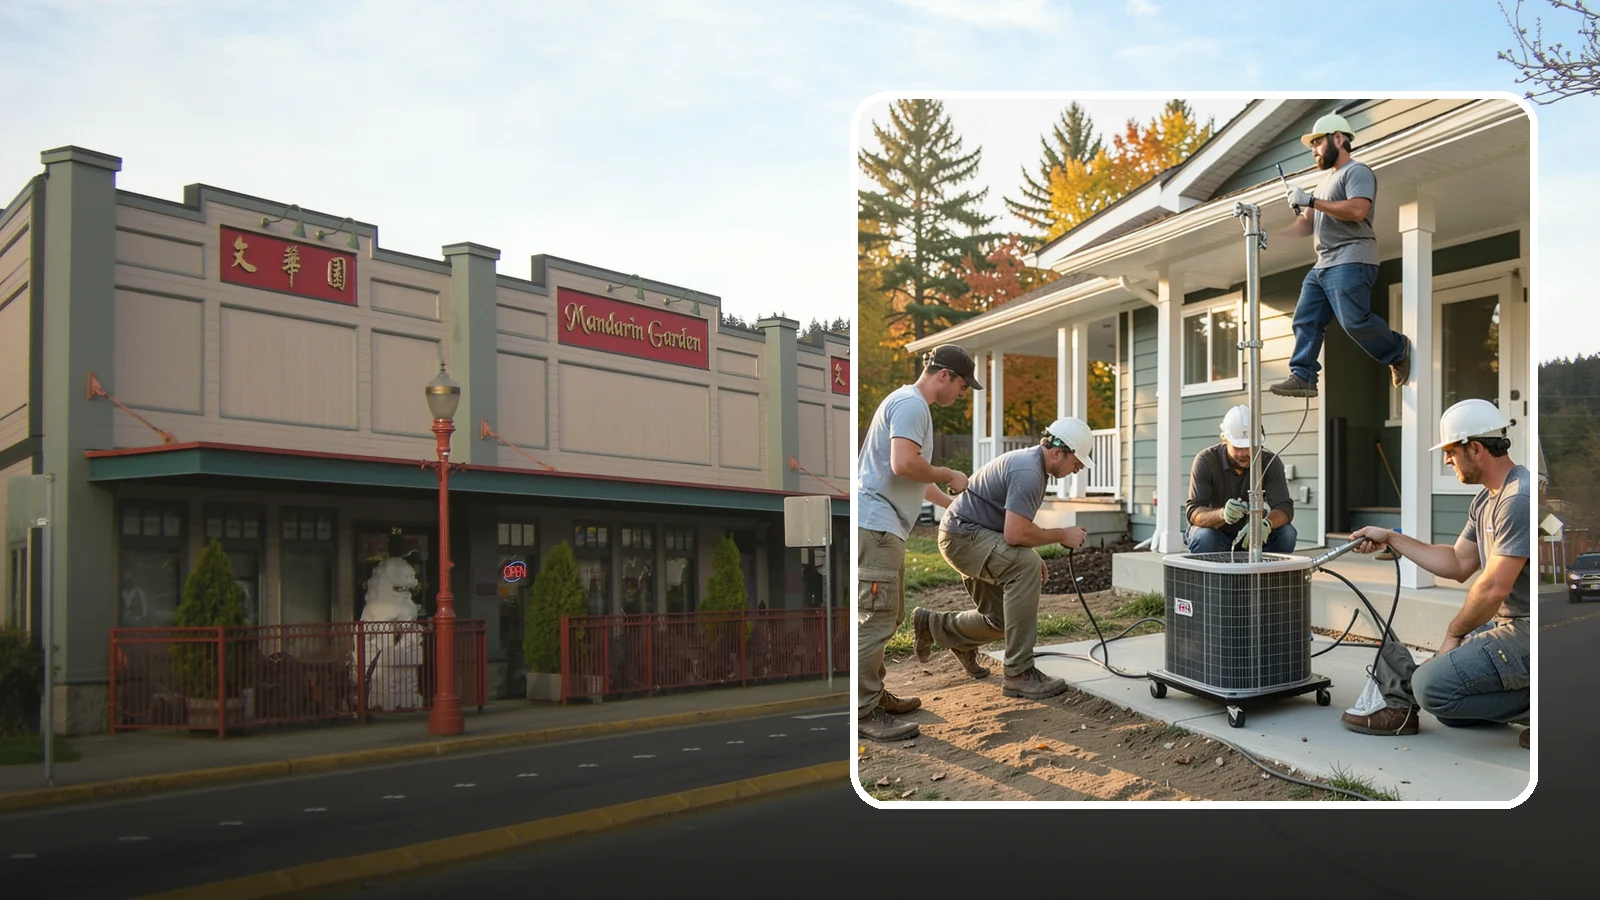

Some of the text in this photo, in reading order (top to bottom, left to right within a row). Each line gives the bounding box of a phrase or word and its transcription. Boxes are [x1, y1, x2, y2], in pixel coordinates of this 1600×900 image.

[231, 236, 346, 291] 文華園
[565, 303, 701, 352] Mandarin Garden
[834, 363, 846, 386] 文
[503, 565, 527, 578] OPEN
